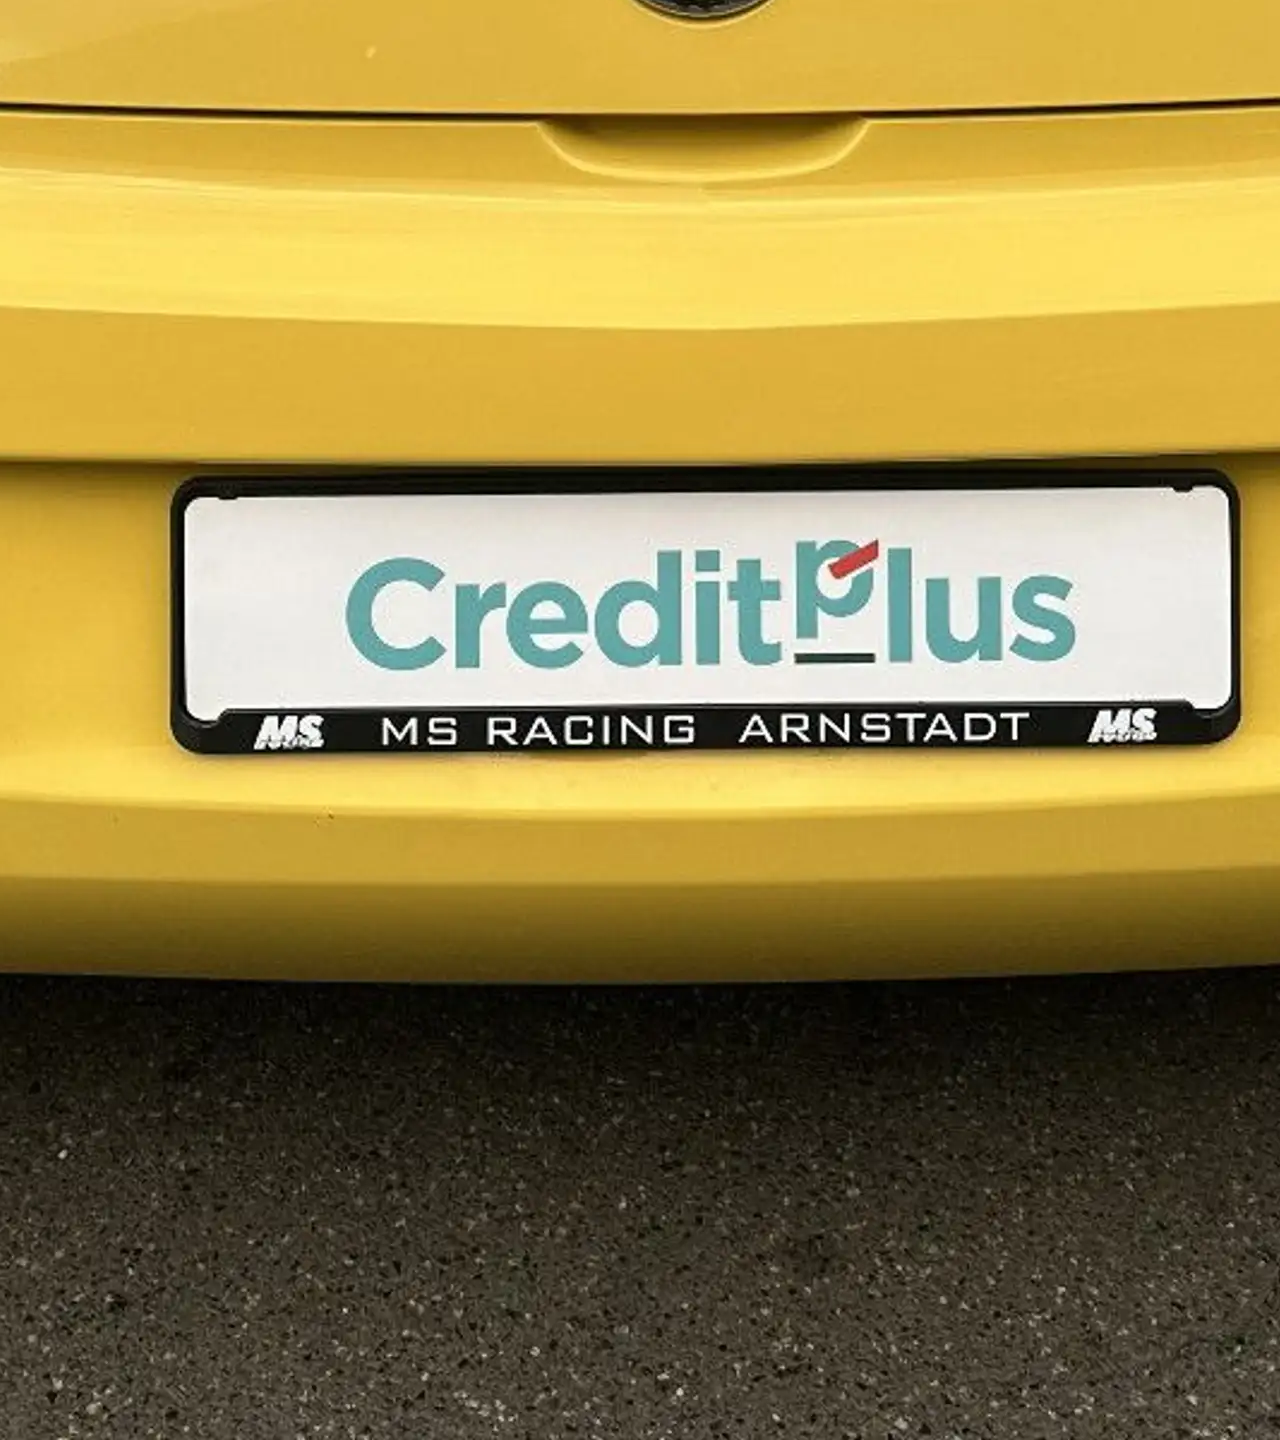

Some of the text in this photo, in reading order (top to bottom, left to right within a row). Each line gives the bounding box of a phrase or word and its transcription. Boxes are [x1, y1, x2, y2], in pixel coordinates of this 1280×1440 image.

[345, 539, 1077, 671] CreditPlus
[254, 714, 325, 750] MS
[381, 717, 458, 746] MS
[486, 715, 696, 746] RACING
[738, 711, 1030, 744] ARNSTADT
[1086, 707, 1158, 743] MS
